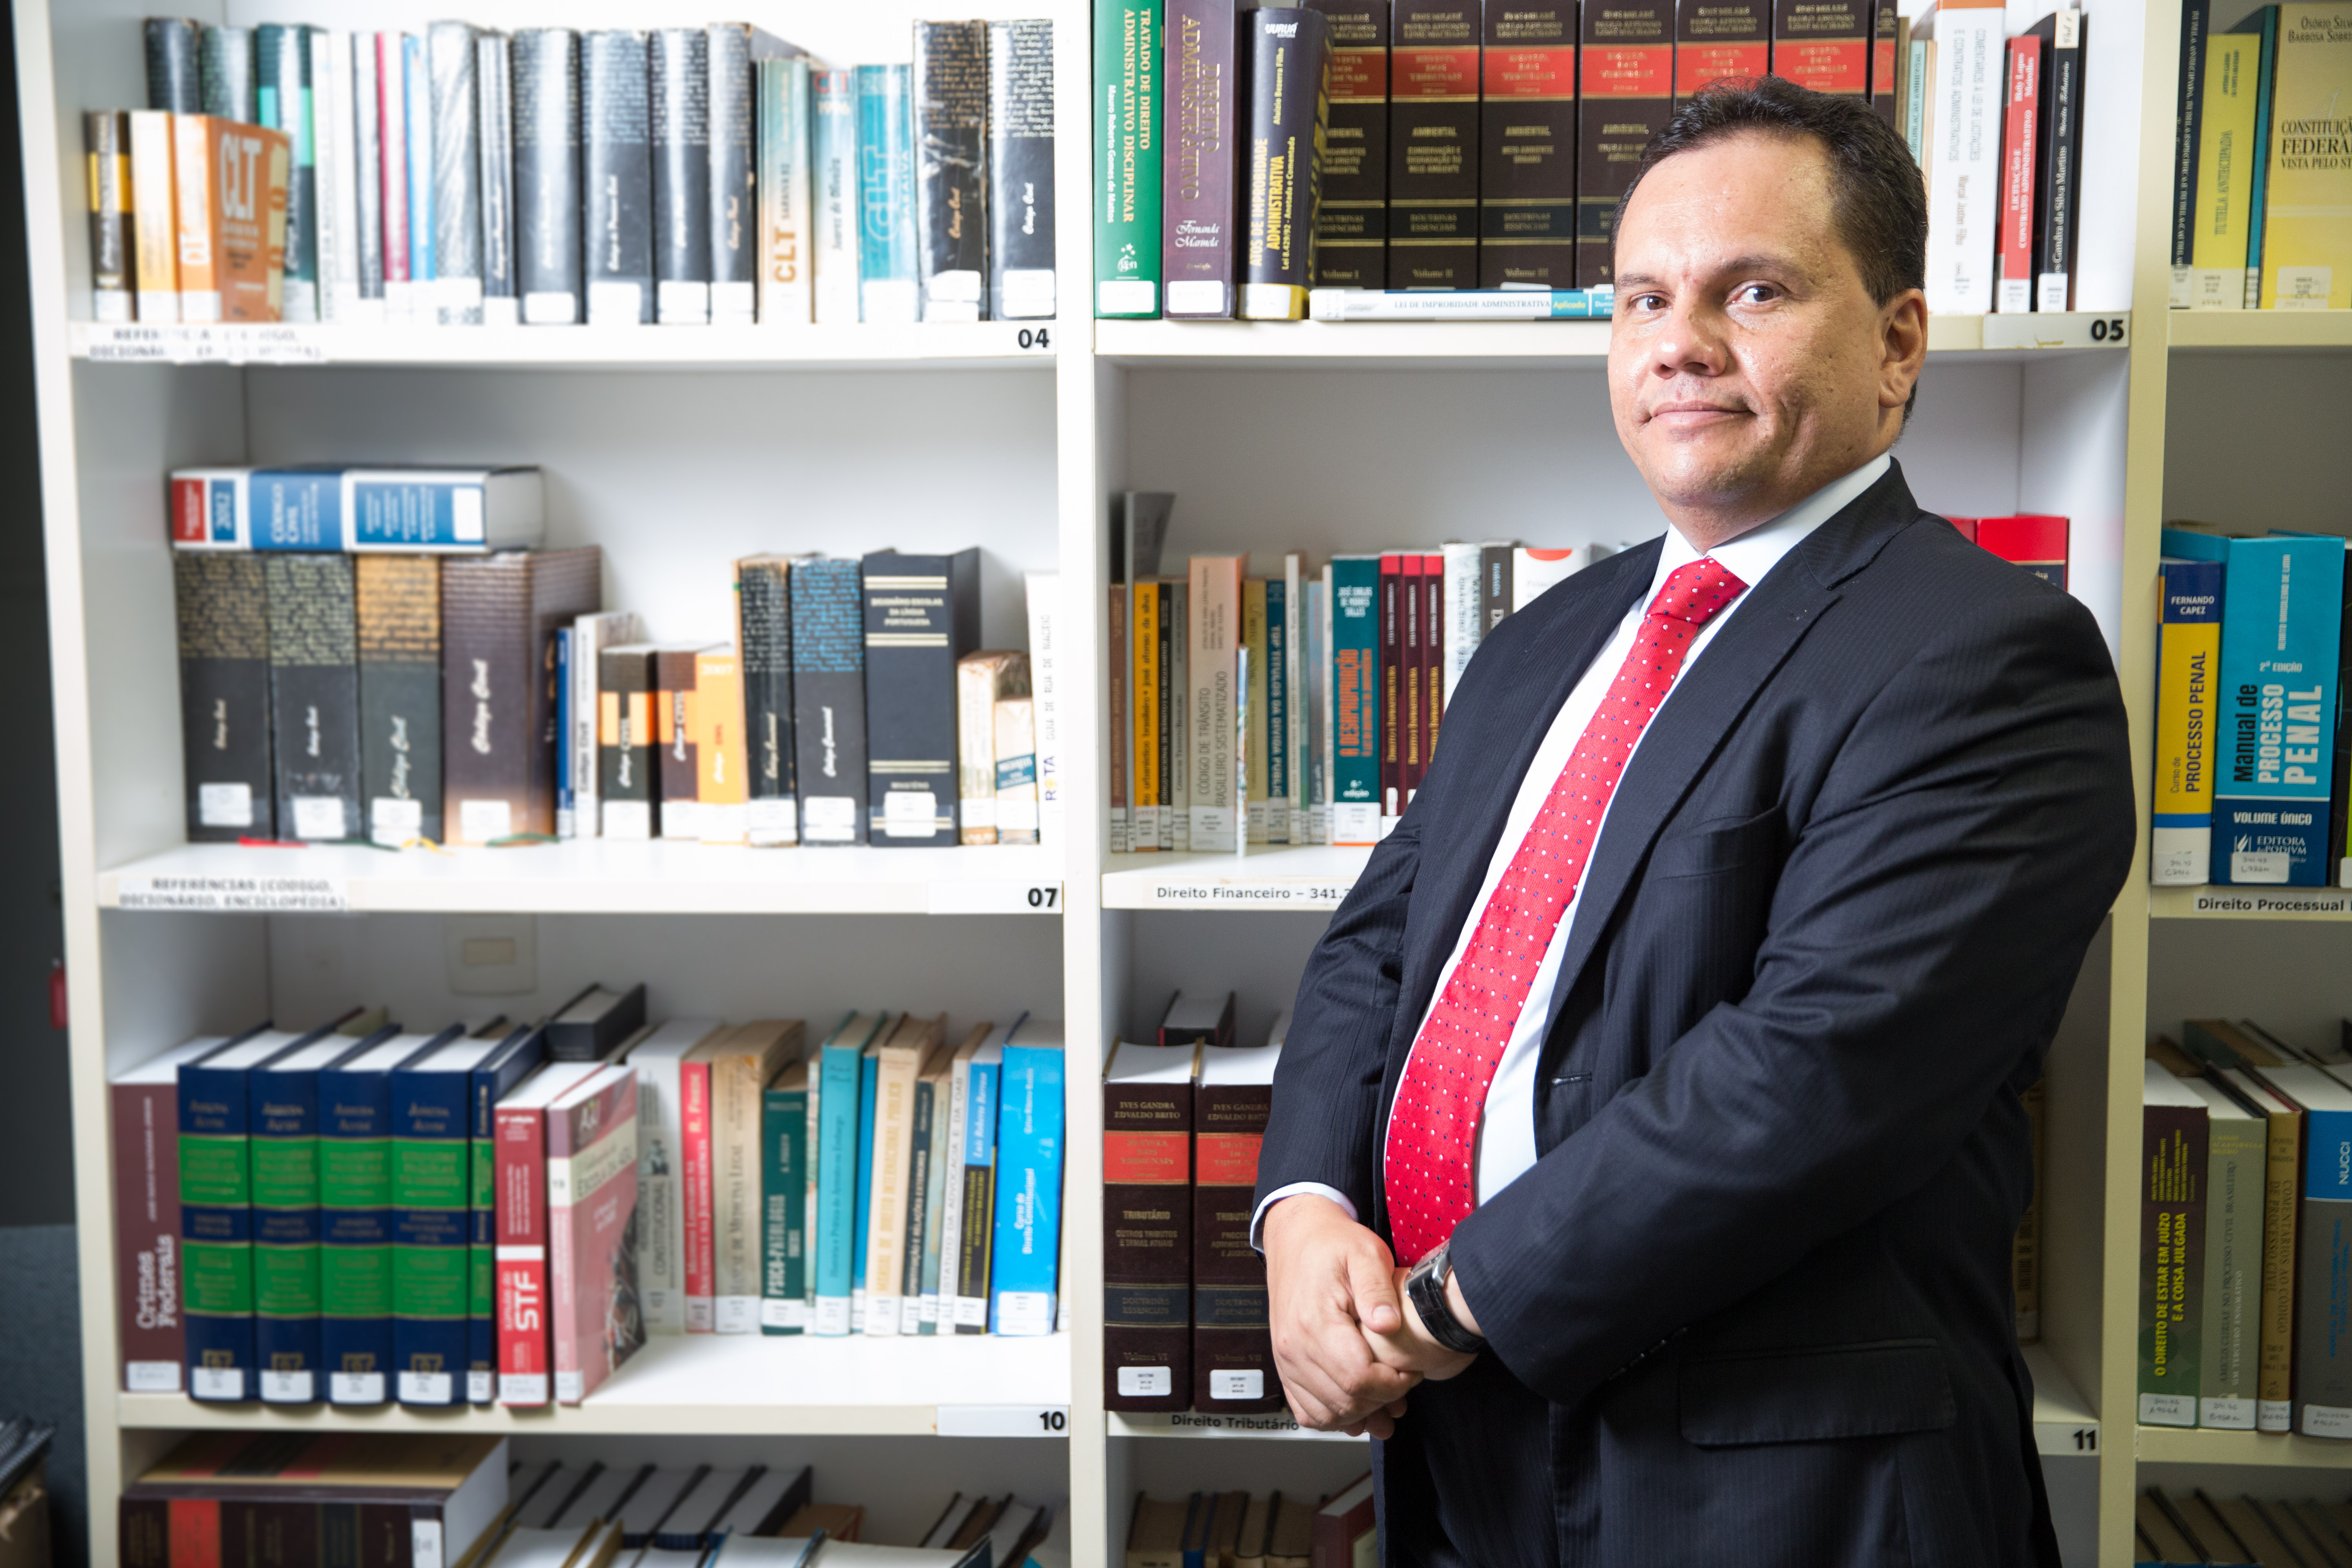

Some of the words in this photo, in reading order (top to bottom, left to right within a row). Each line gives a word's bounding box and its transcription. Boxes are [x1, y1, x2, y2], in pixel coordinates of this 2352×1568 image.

[2334, 16, 2352, 29] SILV
[1140, 9, 1151, 71] TRATADO
[1123, 9, 1135, 131] ADMINISTRATIVO
[1276, 47, 1284, 67] Filho
[1952, 38, 1964, 87] CONTRATOS
[813, 72, 849, 94] CLT
[1140, 74, 1151, 92] DE
[1275, 69, 1283, 96] Bezerra
[1108, 85, 1116, 113] Mauro
[1180, 14, 1200, 200] ADMINISTRATIVO
[1202, 64, 1220, 152] DIREITO
[1971, 107, 1982, 118] DE
[1107, 114, 1116, 149] Roberto
[1139, 96, 1150, 149] DIREITO
[1107, 150, 1116, 179] Gomes
[1286, 137, 1296, 179] Comentada
[2021, 110, 2033, 193] ADMINISTRATIVO
[2056, 146, 2067, 183] Martins
[2281, 158, 2308, 169] VISTA
[2311, 158, 2336, 169] PELO
[2340, 158, 2352, 169] ST
[220, 131, 263, 221] CLT
[1107, 180, 1116, 192] de
[1123, 135, 1135, 222] DISCIPLINAR
[1251, 138, 1267, 218] IMPROBIDADE
[1107, 193, 1115, 223] Mattos
[1267, 156, 1284, 250] ADMINISTRATIVA
[1284, 187, 1294, 218] Anotada
[2054, 186, 2065, 210] Silva
[1251, 220, 1264, 236] DE
[2018, 195, 2029, 248] CONTRATO
[2054, 212, 2065, 224] da
[1249, 240, 1263, 266] ATOS
[1282, 225, 1291, 256] 8.429/92
[2052, 226, 2065, 263] Gandra
[775, 227, 796, 283] CLT
[1281, 258, 1290, 270] Lei
[1018, 328, 1050, 348] 04
[2091, 320, 2125, 341] 05
[2171, 595, 2215, 605] FERNANDO
[2180, 606, 2206, 615] CAPEZ
[2189, 651, 2205, 704] PENAL
[2236, 684, 2257, 706] de
[1197, 687, 1210, 737] TRÂNSITO
[1214, 671, 1227, 750] SISTEMATIZADO
[1198, 741, 1210, 755] DE
[2234, 713, 2256, 782] Manual
[2258, 684, 2284, 784] PROCESSO
[2284, 685, 2322, 784] PENAL
[1339, 748, 1359, 757] A
[2171, 757, 2181, 768] de
[2185, 708, 2203, 793] PROCESSO
[1196, 757, 1211, 795] CÓDIGO
[2169, 769, 2180, 793] Curso
[2233, 811, 2277, 825] VOLUME
[2281, 811, 2312, 826] ÚNICO
[2257, 835, 2305, 846] EDITORA
[1027, 888, 1058, 908] 07
[1157, 886, 1207, 899] Direito
[1213, 886, 1290, 899] Financeiro
[2198, 898, 2252, 911] Direito
[2259, 898, 2344, 912] Processual
[1140, 1101, 1175, 1109] GANDRA
[1154, 1111, 1180, 1119] BRITO
[2339, 1141, 2351, 1185] NUCCI
[2270, 1180, 2280, 1194] DE
[1123, 1209, 1170, 1220] TRIBUTÁRIO
[2157, 1212, 2170, 1244] JUÍZO
[2267, 1198, 2280, 1259] PROCESSO
[2280, 1180, 2294, 1263] COMENTÁRIOS
[2174, 1213, 2186, 1265] JULGADA
[2158, 1247, 2169, 1263] EM
[2157, 1267, 2169, 1301] ESTAR
[2173, 1267, 2185, 1301] COISA
[2279, 1269, 2290, 1285] AO
[514, 1272, 539, 1331] STF
[2156, 1303, 2167, 1318] DE
[2173, 1303, 2183, 1312] A
[2277, 1288, 2290, 1334] CÓDIGO
[2155, 1321, 2167, 1364] DIREITO
[2154, 1367, 2166, 1376] O
[1039, 1411, 1065, 1431] 10
[1172, 1414, 1222, 1428] Direito
[1227, 1416, 1299, 1431] Tributário
[2072, 1429, 2096, 1451] 11
